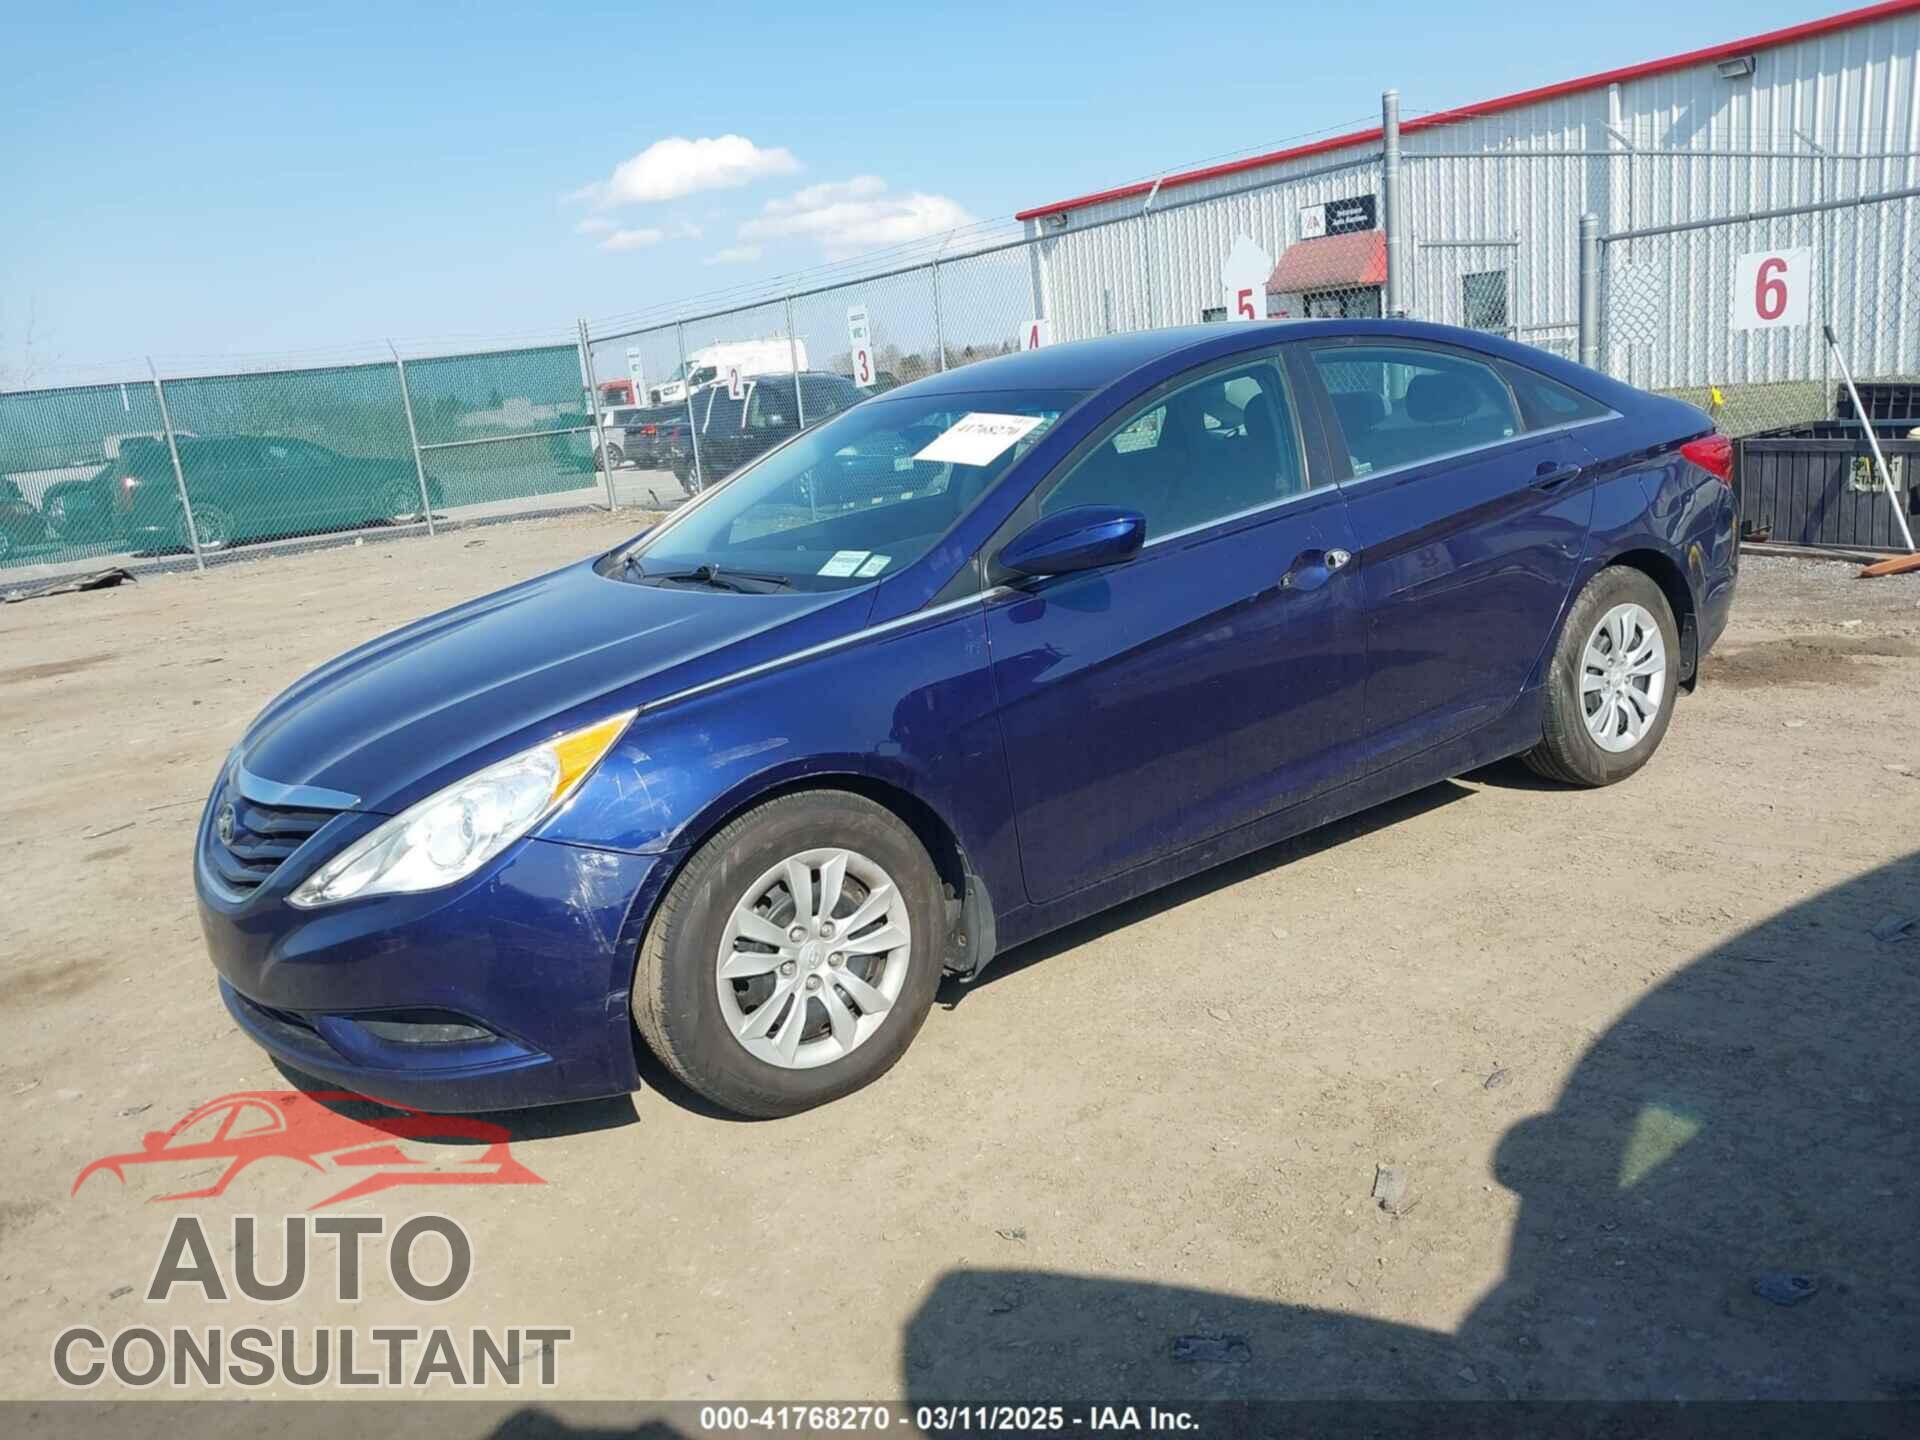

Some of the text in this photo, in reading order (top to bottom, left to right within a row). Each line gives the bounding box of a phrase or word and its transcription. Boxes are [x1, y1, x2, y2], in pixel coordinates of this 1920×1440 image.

[1237, 288, 1256, 319] 5
[1755, 257, 1788, 320] 6
[858, 350, 869, 382] 3
[730, 368, 740, 396] 2
